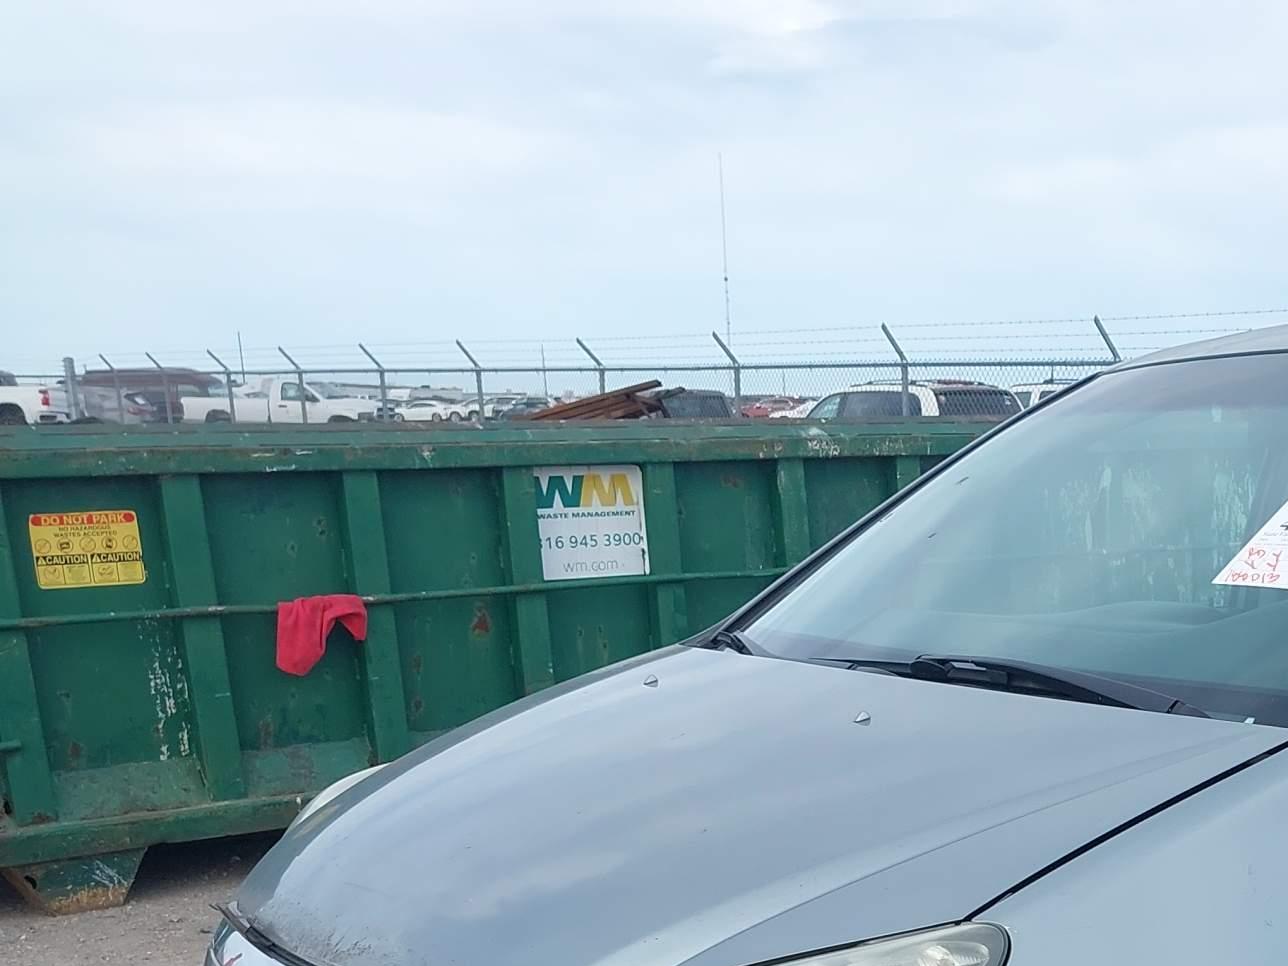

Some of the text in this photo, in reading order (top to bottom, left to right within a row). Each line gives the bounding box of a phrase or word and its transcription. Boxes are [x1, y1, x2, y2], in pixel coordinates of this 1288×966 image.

[41, 512, 126, 526] DO NOT PARK
[537, 509, 636, 520] WASTE MANAGEMENT
[83, 529, 117, 537] ACCEPTED
[569, 534, 598, 549] 945
[603, 532, 641, 547] 3900
[46, 554, 87, 565] CAUTION
[100, 552, 140, 562] CAUTION
[563, 559, 618, 573] wm.com
